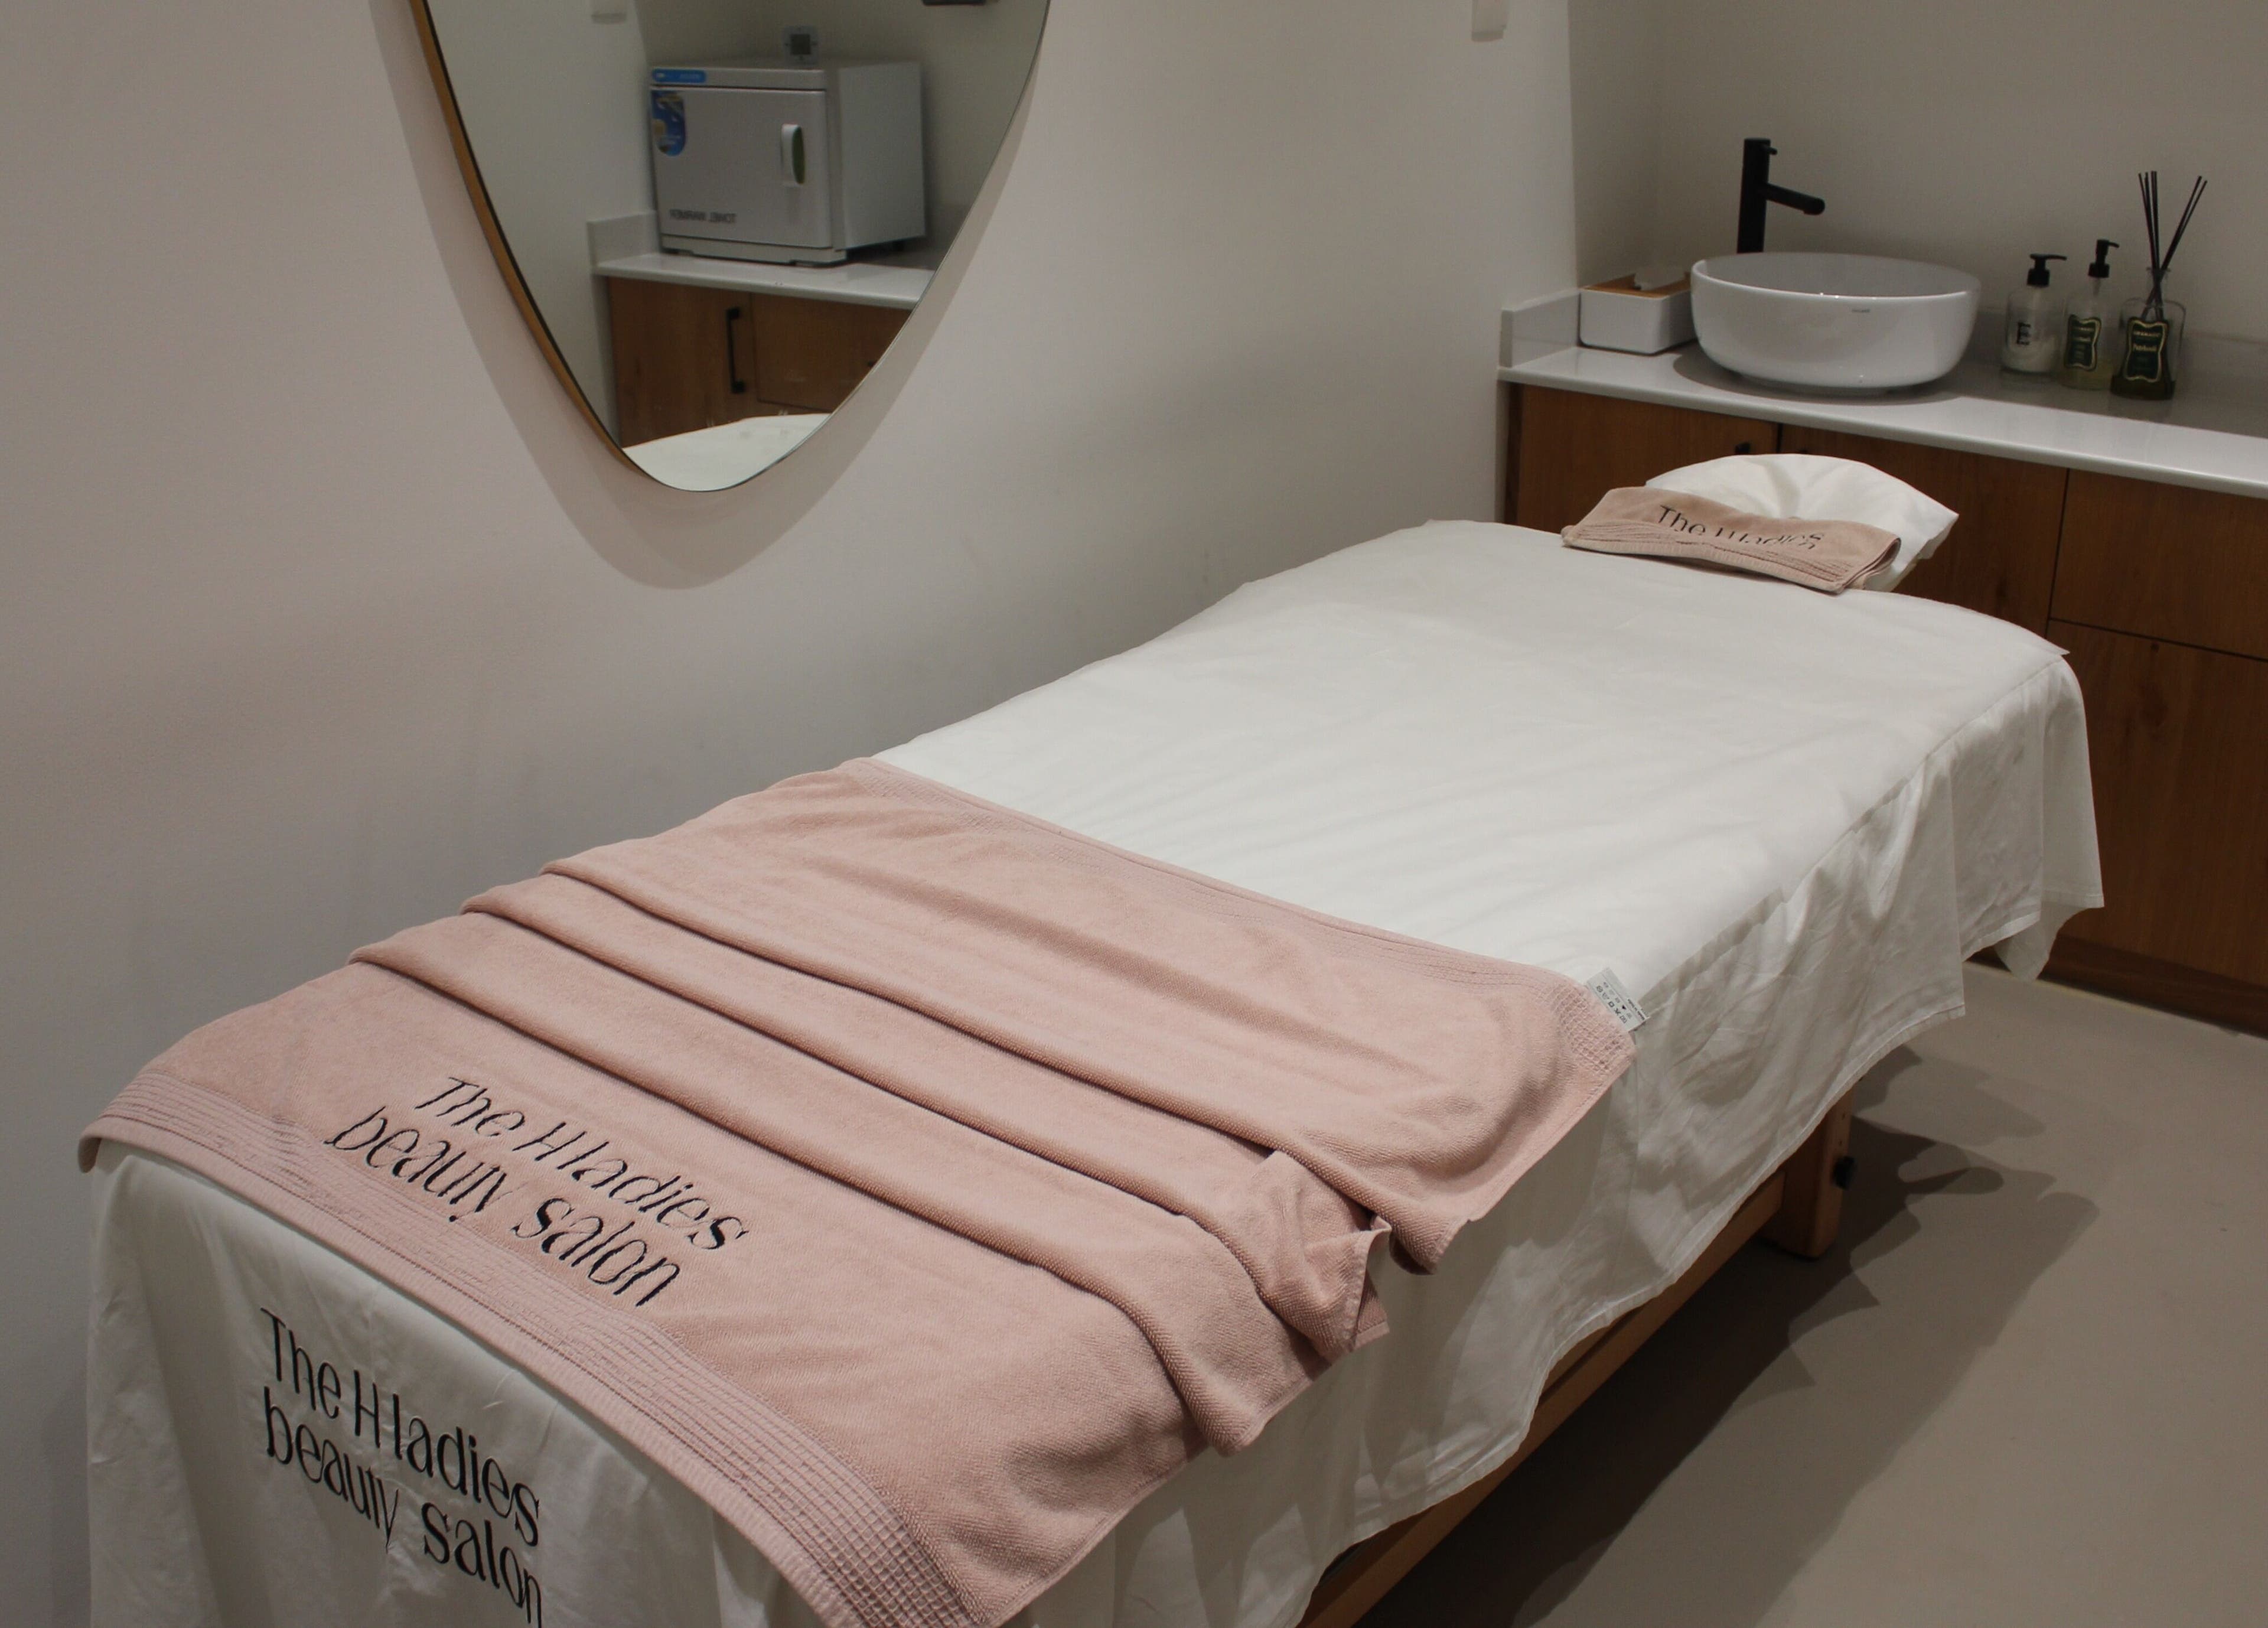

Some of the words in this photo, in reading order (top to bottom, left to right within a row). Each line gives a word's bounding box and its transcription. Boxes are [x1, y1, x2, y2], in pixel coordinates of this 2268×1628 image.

[1658, 505, 1706, 536] The
[415, 1076, 525, 1137] The
[323, 1105, 522, 1223] beauty
[512, 1197, 680, 1307] salon
[260, 1307, 341, 1419] The
[263, 1385, 399, 1554] beauty
[421, 1502, 542, 1628] salon
